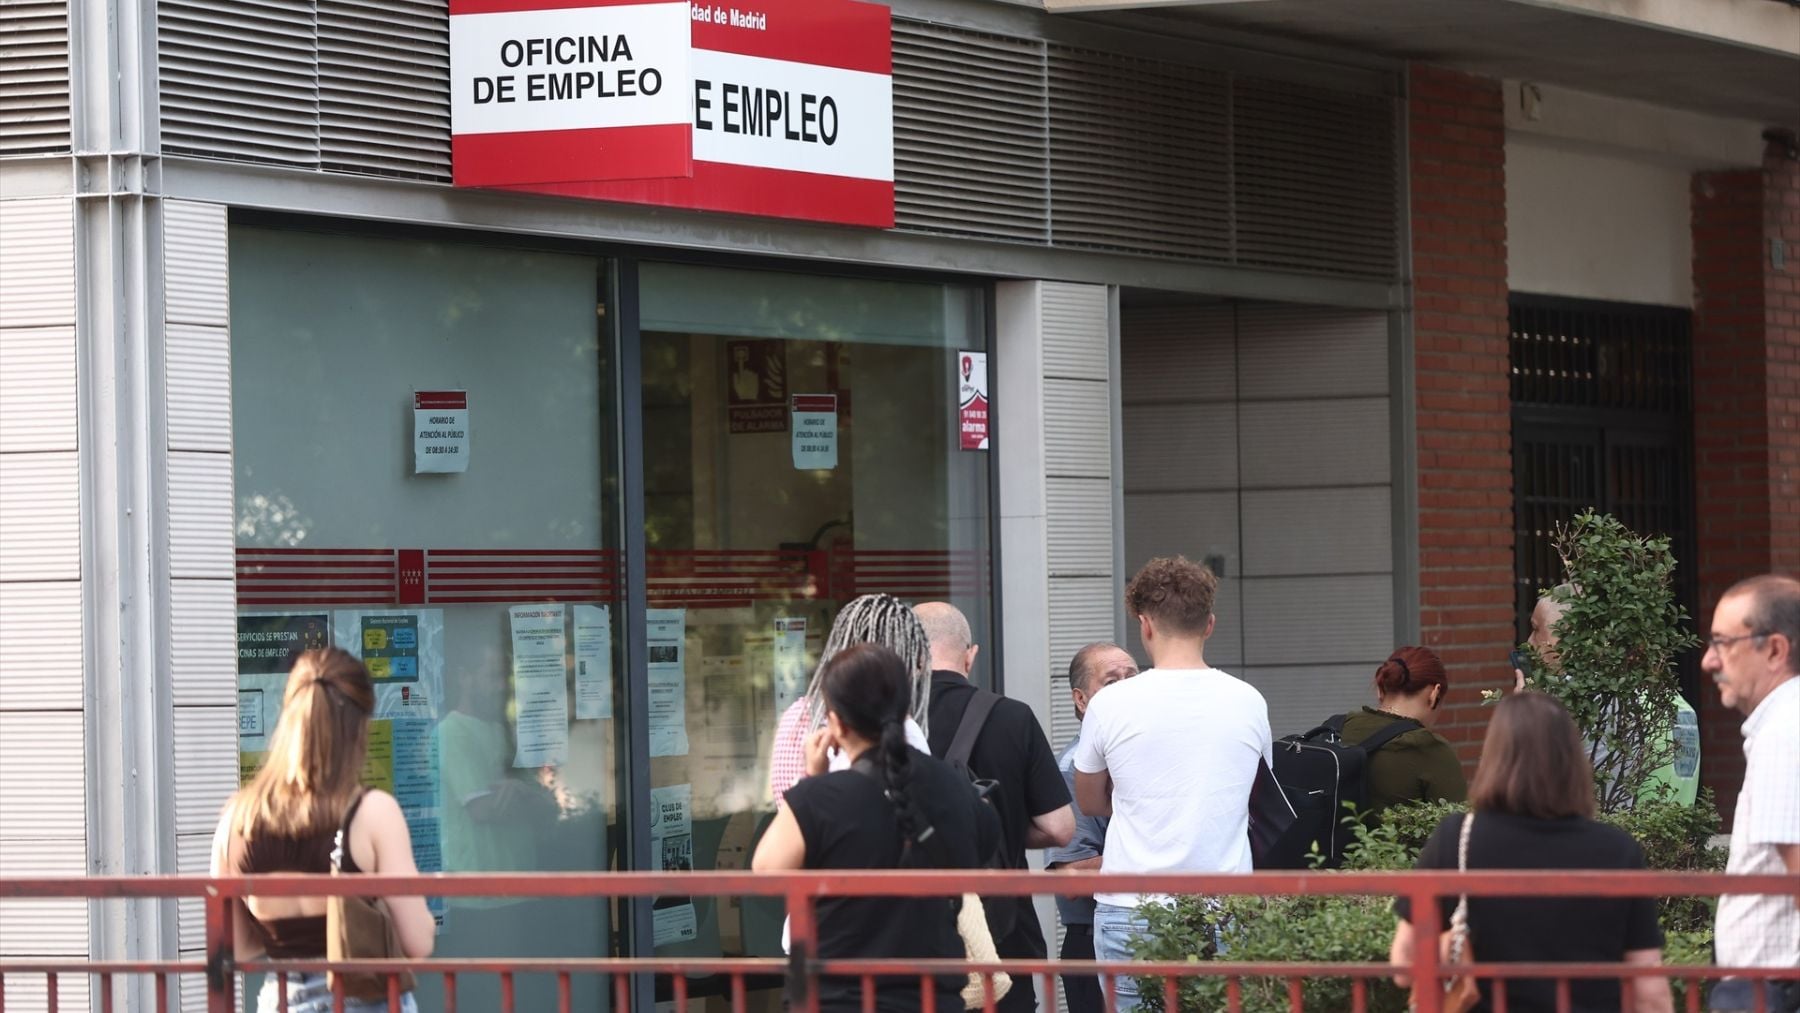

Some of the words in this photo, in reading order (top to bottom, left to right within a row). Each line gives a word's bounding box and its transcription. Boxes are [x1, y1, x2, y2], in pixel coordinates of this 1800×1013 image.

[691, 3, 711, 23] dad
[714, 6, 727, 25] de
[730, 8, 766, 31] Madrid
[500, 34, 633, 68] OFICINA
[473, 76, 516, 105] DE
[527, 67, 662, 102] EMPLEO
[692, 79, 713, 130] E
[722, 82, 838, 146] EMPLEO
[429, 416, 448, 425] HORARIO
[449, 416, 455, 424] DE
[962, 420, 986, 432] alarma
[420, 429, 441, 439] ATENCIÓN
[442, 430, 448, 438] AL
[448, 429, 464, 439] PÚBLICO
[266, 632, 273, 640] SE
[273, 631, 298, 640] PRESTAN
[238, 649, 257, 658] CINAS
[258, 649, 264, 657] DE
[265, 647, 290, 657] EMPLEO?
[239, 715, 256, 729] EPE
